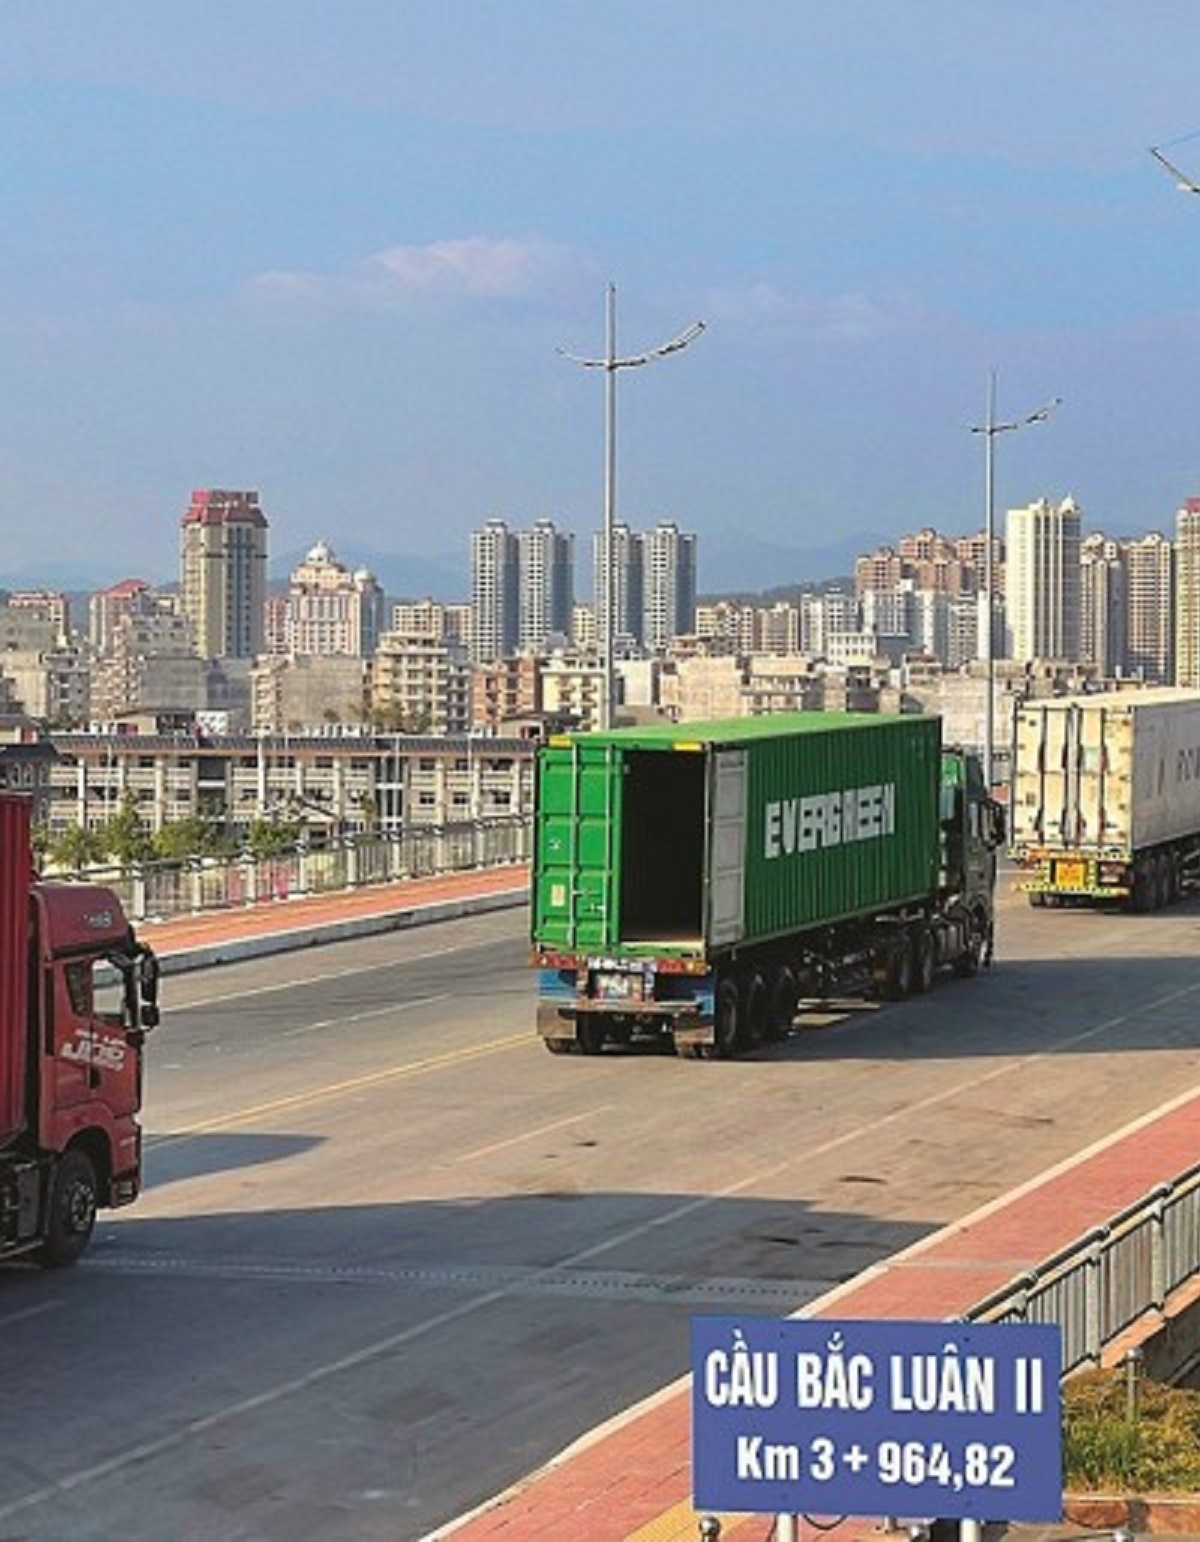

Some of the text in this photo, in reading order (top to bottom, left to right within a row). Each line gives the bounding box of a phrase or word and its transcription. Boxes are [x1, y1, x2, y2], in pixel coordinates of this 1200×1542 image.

[764, 782, 896, 860] EVERGREEN
[705, 1329, 1043, 1413] CẦU BẮC LUÂN II
[737, 1436, 799, 1481] Km
[810, 1437, 835, 1481] 3
[878, 1441, 1015, 1491] 964,82
